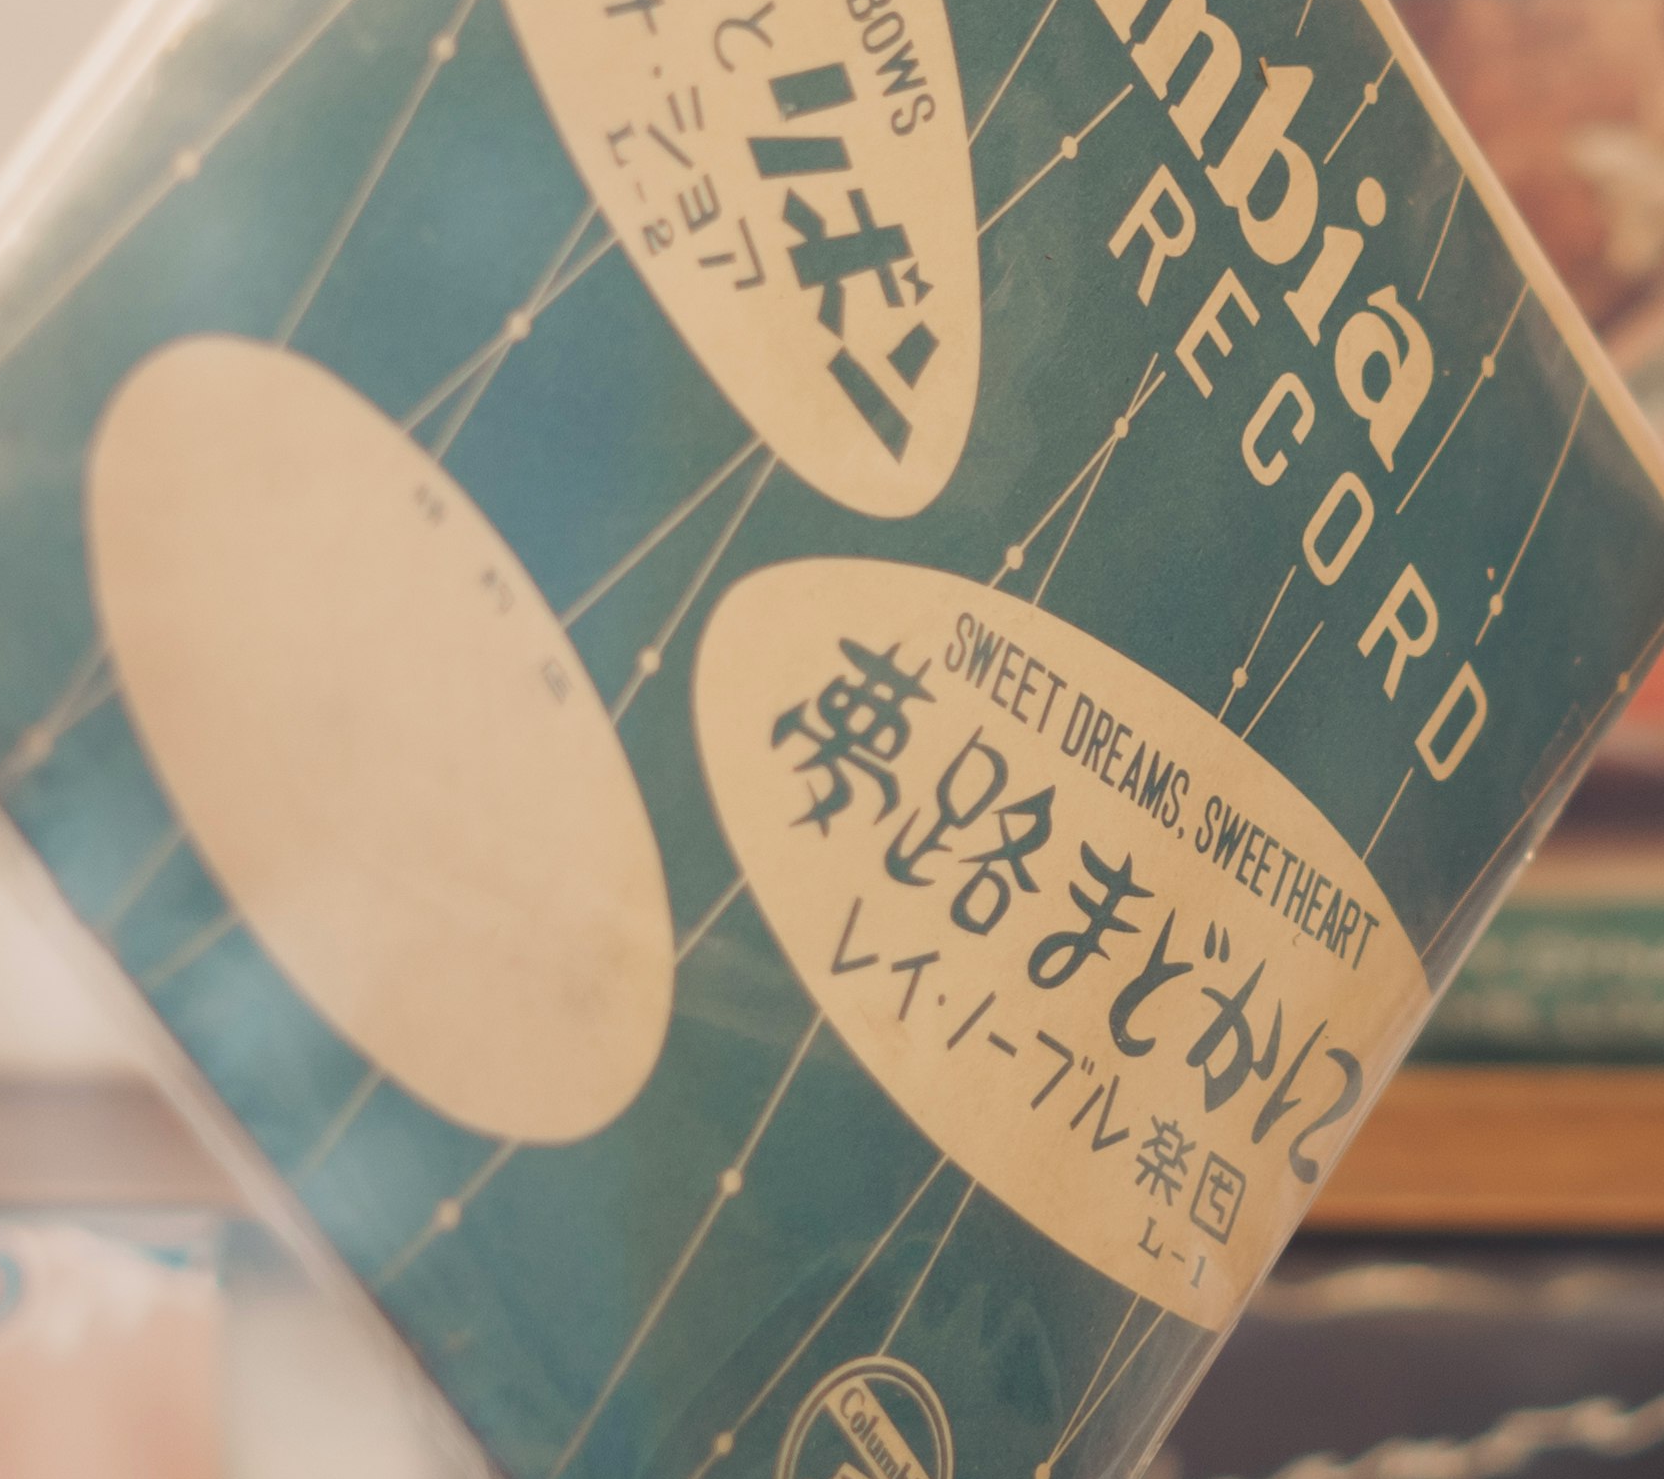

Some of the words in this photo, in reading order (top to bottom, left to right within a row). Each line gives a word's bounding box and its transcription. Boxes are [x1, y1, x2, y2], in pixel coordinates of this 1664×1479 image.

[1107, 164, 1488, 781] RECORD
[769, 637, 1363, 1186] 夢路まどかに
[944, 611, 1067, 735] SWEET
[1058, 693, 1191, 841] DREAMS,
[1193, 794, 1380, 972] SWEETHEART
[1137, 1215, 1210, 1291] L-1
